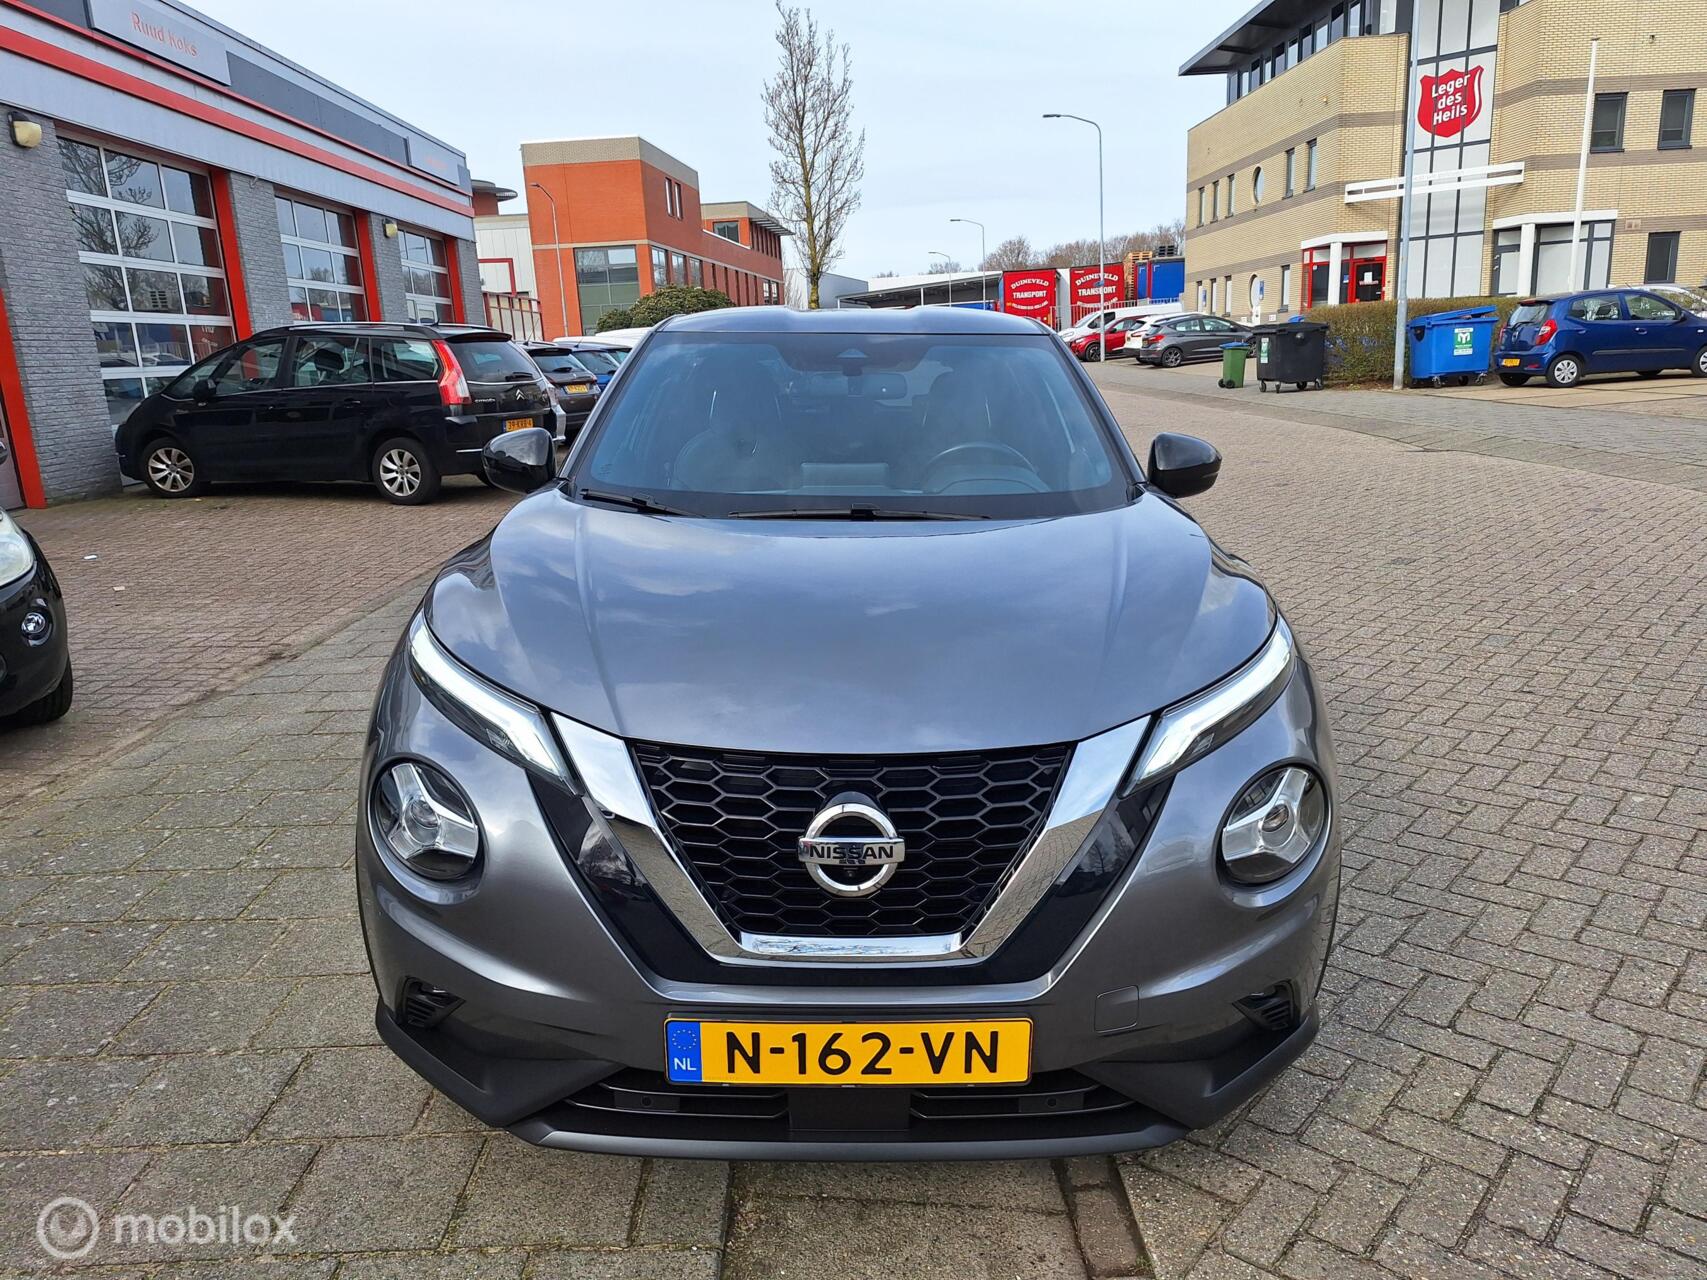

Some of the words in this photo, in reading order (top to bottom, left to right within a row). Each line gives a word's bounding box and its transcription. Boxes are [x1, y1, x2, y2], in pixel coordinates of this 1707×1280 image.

[131, 10, 165, 42] Ruud
[1431, 74, 1471, 98] Leger
[1437, 92, 1462, 110] des
[1433, 104, 1468, 126] Heils
[1010, 278, 1049, 289] DUINEVELD
[1077, 286, 1116, 296] TRANSORT
[1012, 290, 1047, 299] TRANSPORT
[809, 845, 894, 860] NISSAN
[673, 1057, 697, 1071] NL
[726, 1031, 999, 1076] N-162-VN
